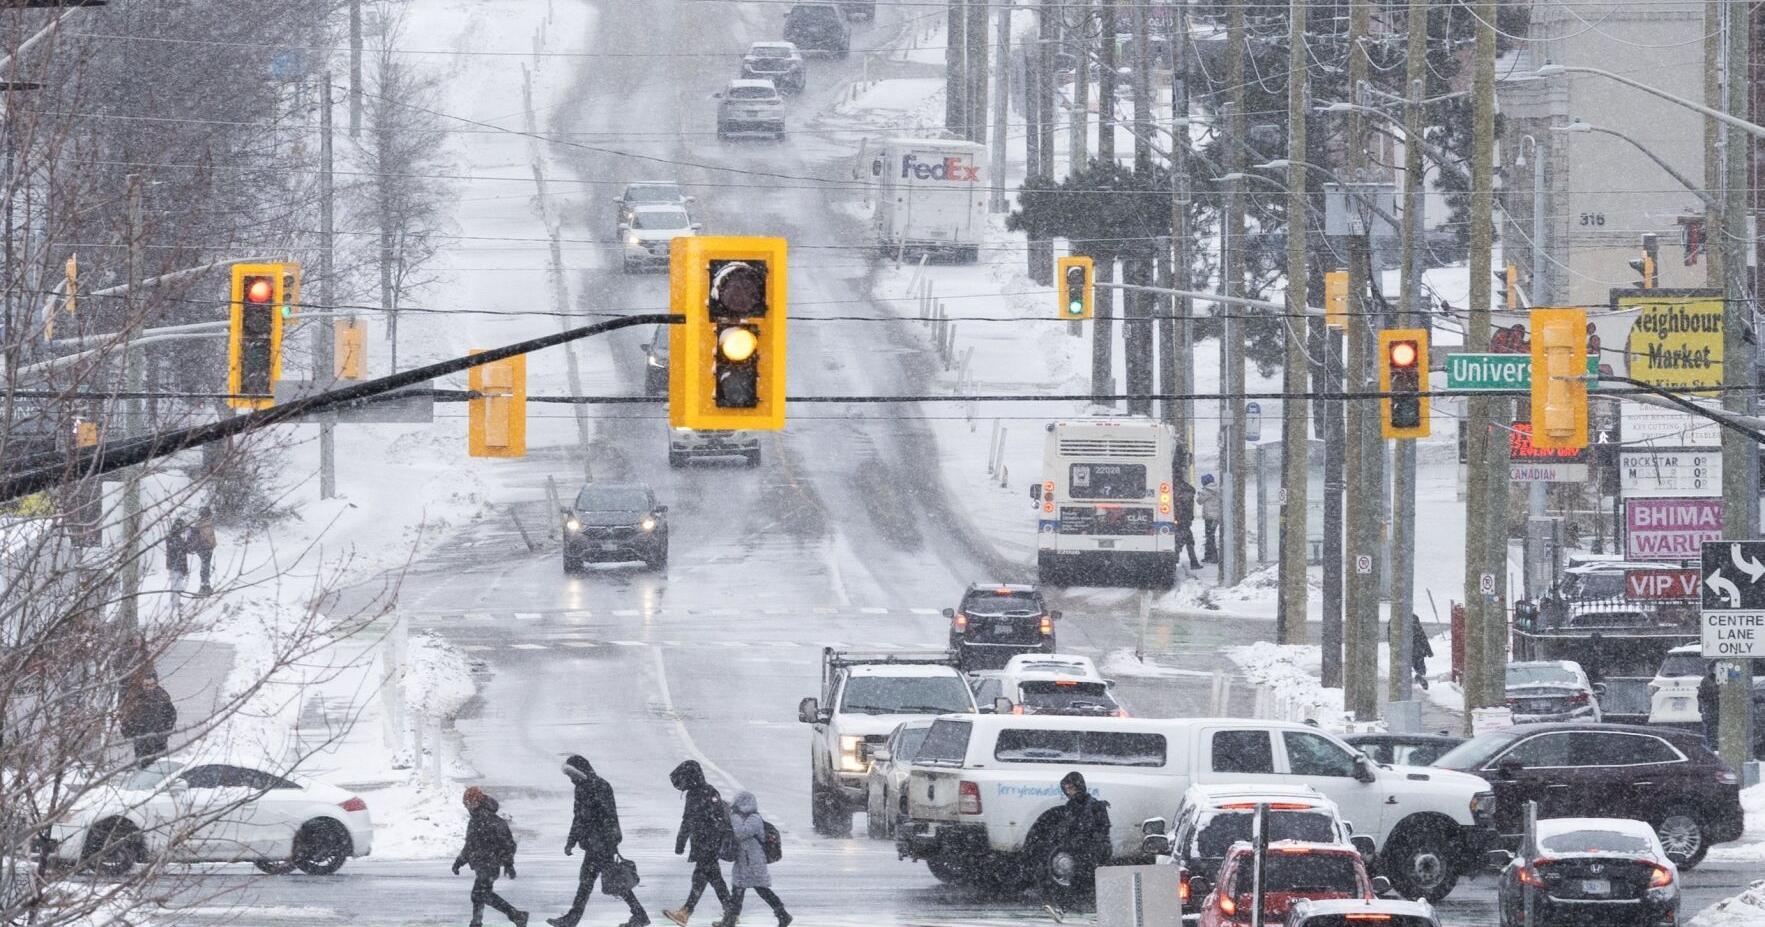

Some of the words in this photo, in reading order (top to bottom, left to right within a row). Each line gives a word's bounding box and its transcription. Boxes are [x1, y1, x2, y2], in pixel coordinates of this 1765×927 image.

[902, 154, 980, 181] FedEx
[1648, 342, 1711, 369] Market
[1623, 457, 1678, 467] ROCKSTAR
[1511, 468, 1556, 480] CANADIAN
[1631, 575, 1672, 595] VIP
[1708, 615, 1764, 627] CENTRE
[1718, 629, 1754, 640] LANE
[1718, 642, 1754, 654] ONLY
